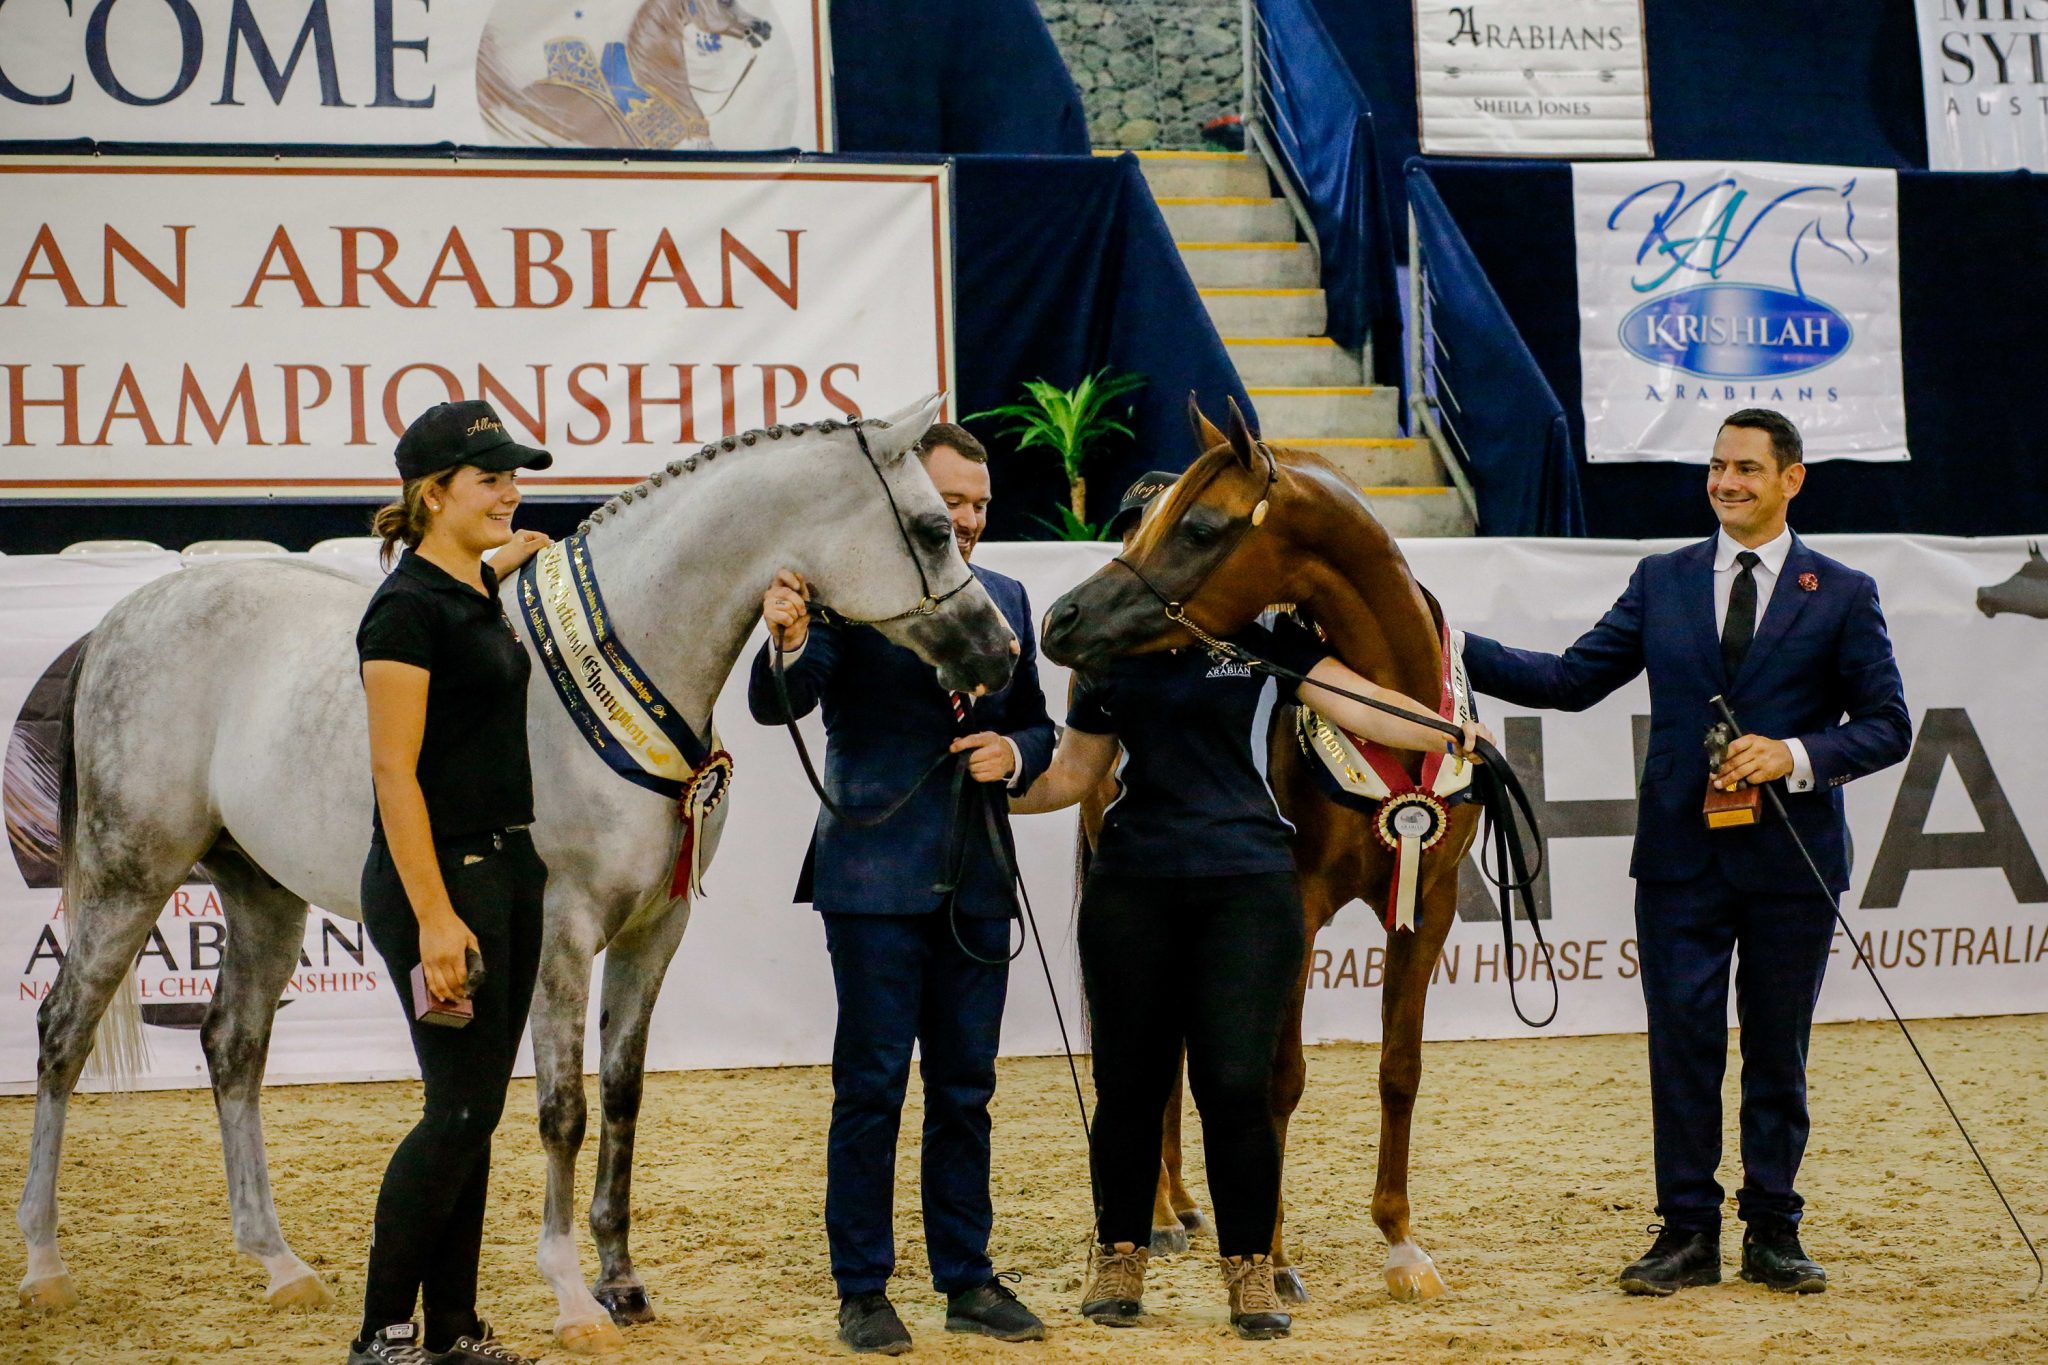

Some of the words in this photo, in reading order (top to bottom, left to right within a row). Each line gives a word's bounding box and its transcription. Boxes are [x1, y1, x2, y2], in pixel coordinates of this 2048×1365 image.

[1448, 6, 1624, 50] ARABIANS
[1538, 100, 1591, 116] JONES
[0, 222, 196, 309] AN
[232, 224, 808, 311] ARABIAN
[1646, 314, 1831, 351] KRISHLAH
[1206, 665, 1251, 677] ARABIAN
[581, 655, 649, 747] Champion
[1474, 940, 1607, 983] HORSE
[159, 970, 377, 997] CHANSHIPS
